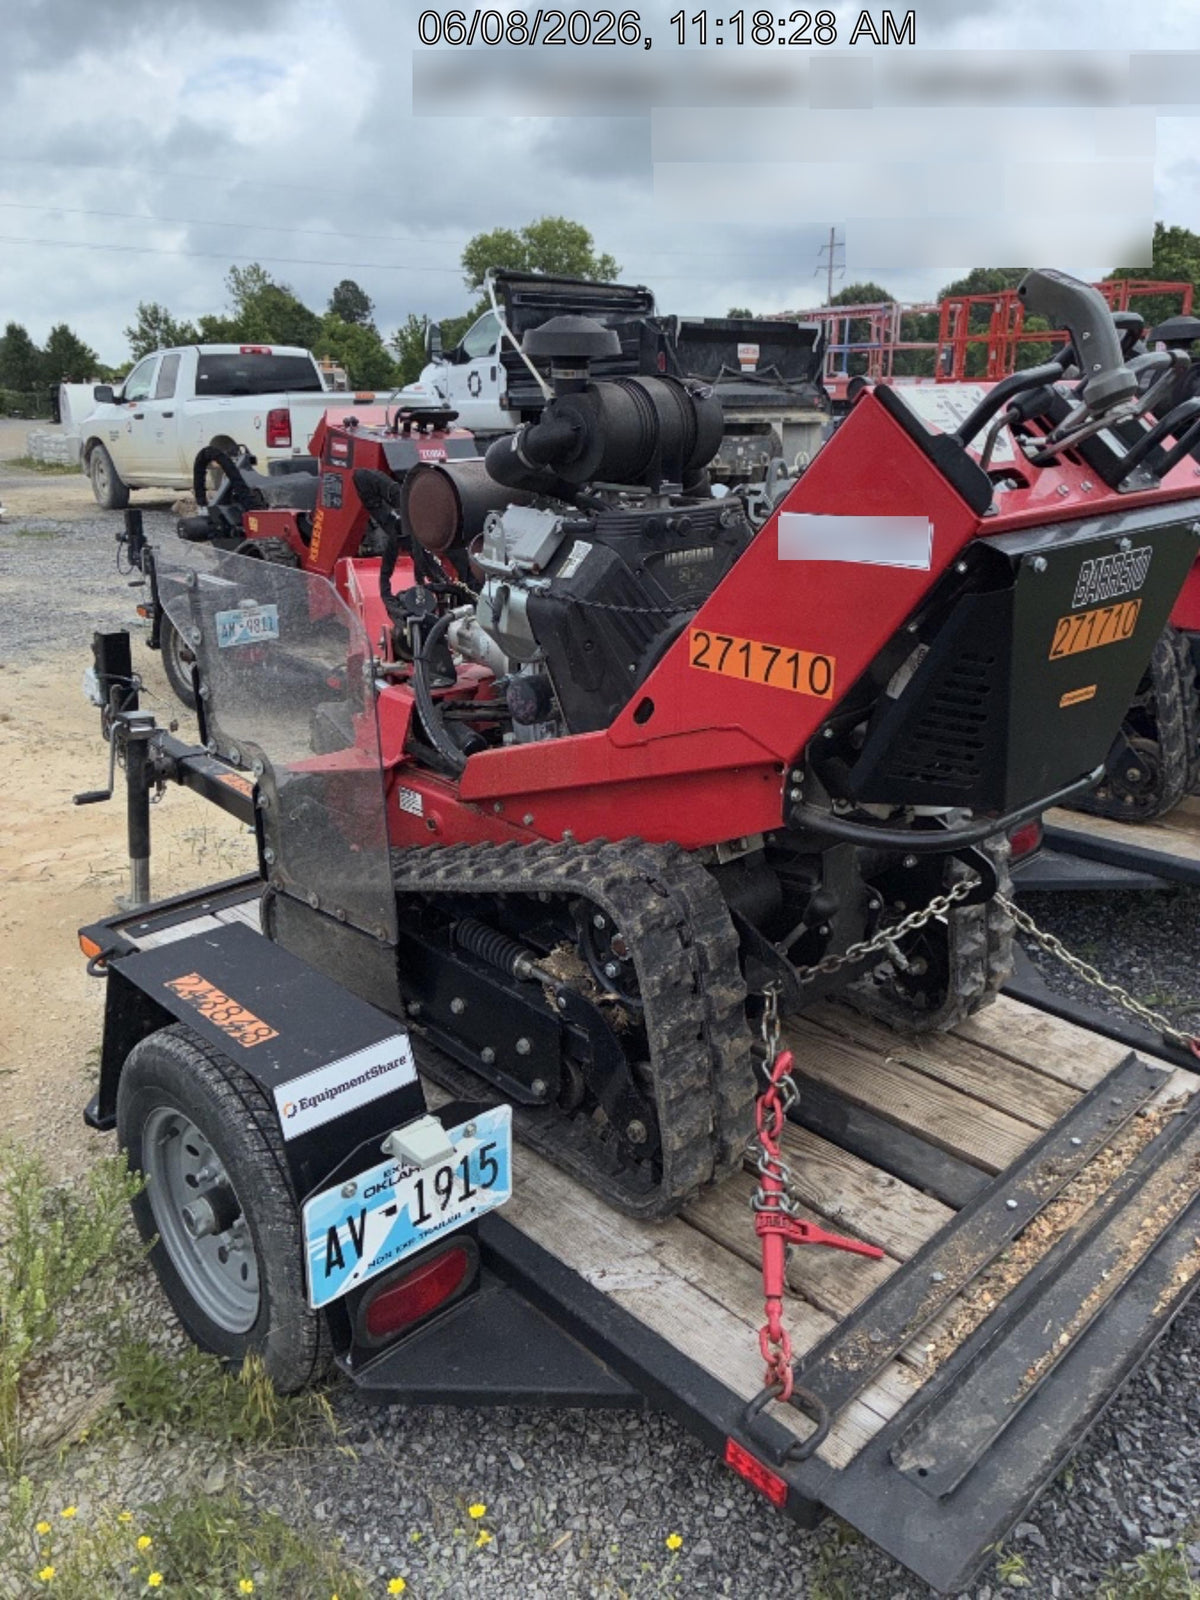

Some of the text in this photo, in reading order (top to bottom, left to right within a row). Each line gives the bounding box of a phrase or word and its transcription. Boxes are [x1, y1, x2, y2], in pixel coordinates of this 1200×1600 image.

[1051, 600, 1139, 656] 271710
[692, 631, 833, 696] 271710
[298, 1055, 407, 1112] EquipmentShare
